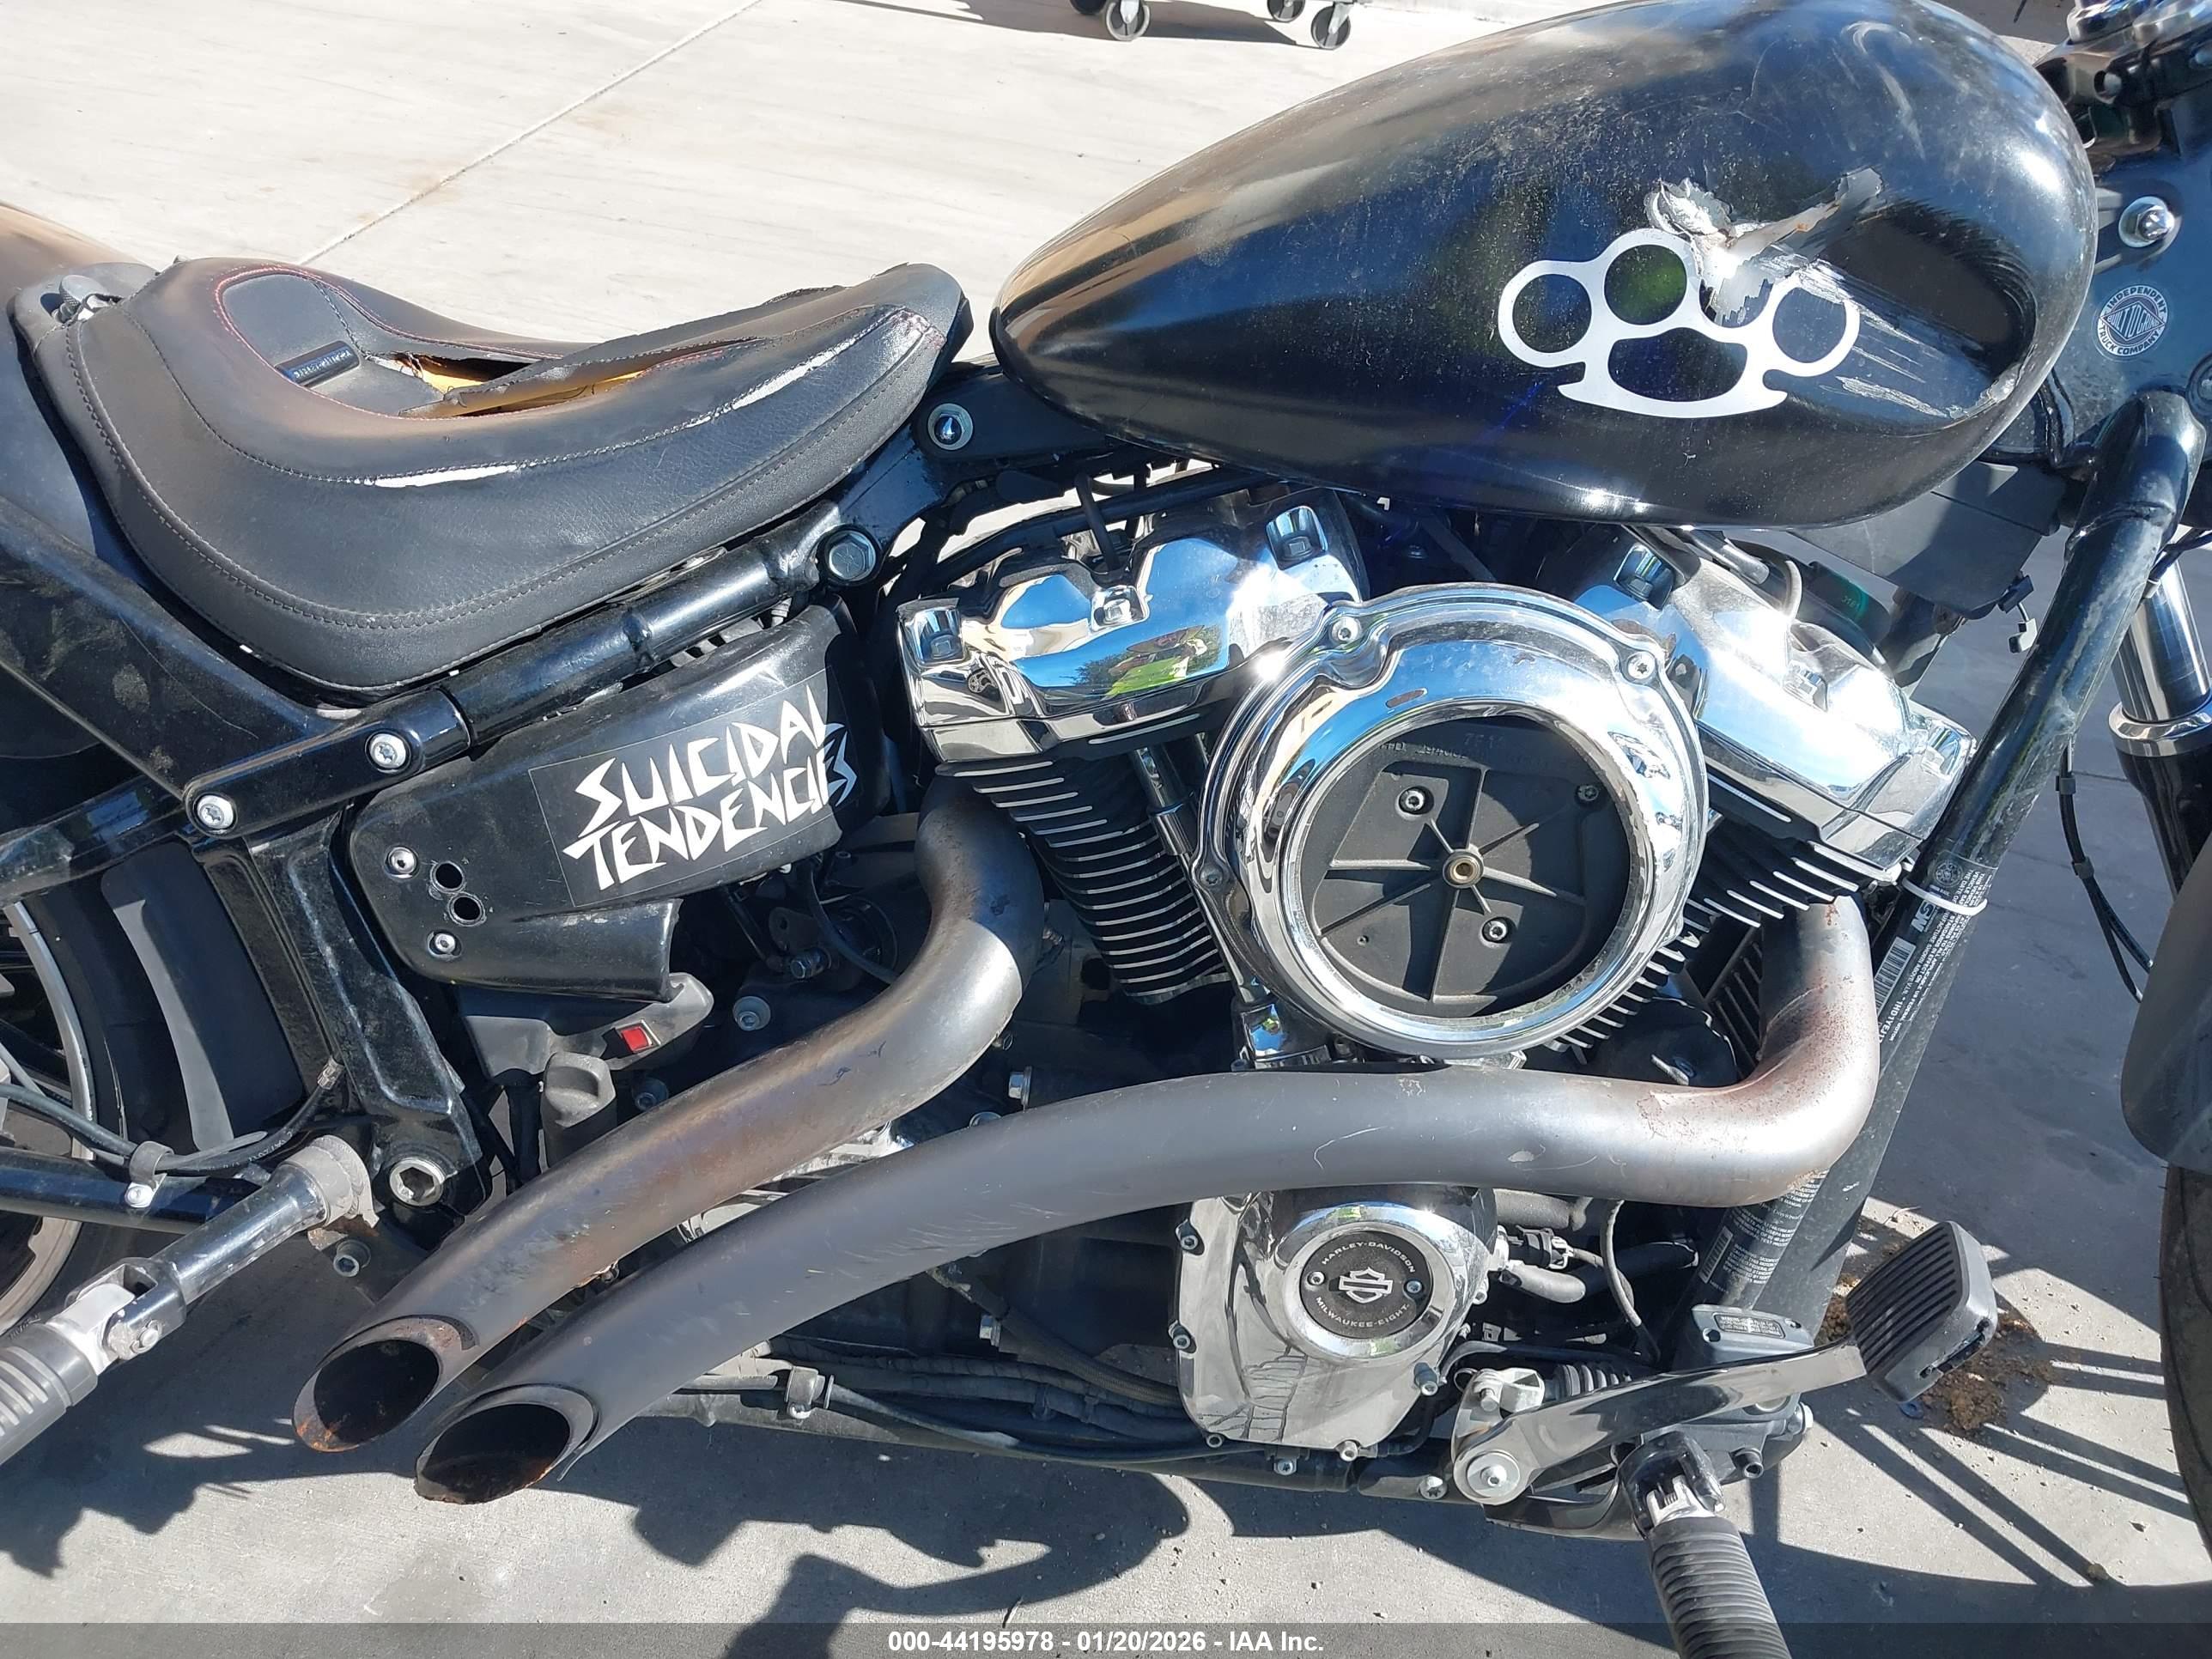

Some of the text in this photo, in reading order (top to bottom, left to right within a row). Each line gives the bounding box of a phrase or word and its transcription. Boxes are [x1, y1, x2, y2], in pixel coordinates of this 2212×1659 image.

[2107, 286, 2166, 313] INDEPENDENT
[2098, 325, 2160, 355] TRUCK COMPANY
[574, 685, 845, 838] SUICIDAL
[562, 731, 857, 890] TENDENCIES
[1955, 878, 1967, 896] DATE
[1963, 867, 1974, 881] THE
[1963, 869, 1980, 896] VEHICLE
[1918, 952, 1934, 975] EFFECT
[1934, 946, 1943, 957] ALL
[1906, 962, 1921, 982] ABOVE
[1899, 997, 1916, 1023] FEDERAL
[1887, 1021, 1902, 1042] MOTOR
[1322, 1242, 1416, 1273] HARLEY-DAVIDSON
